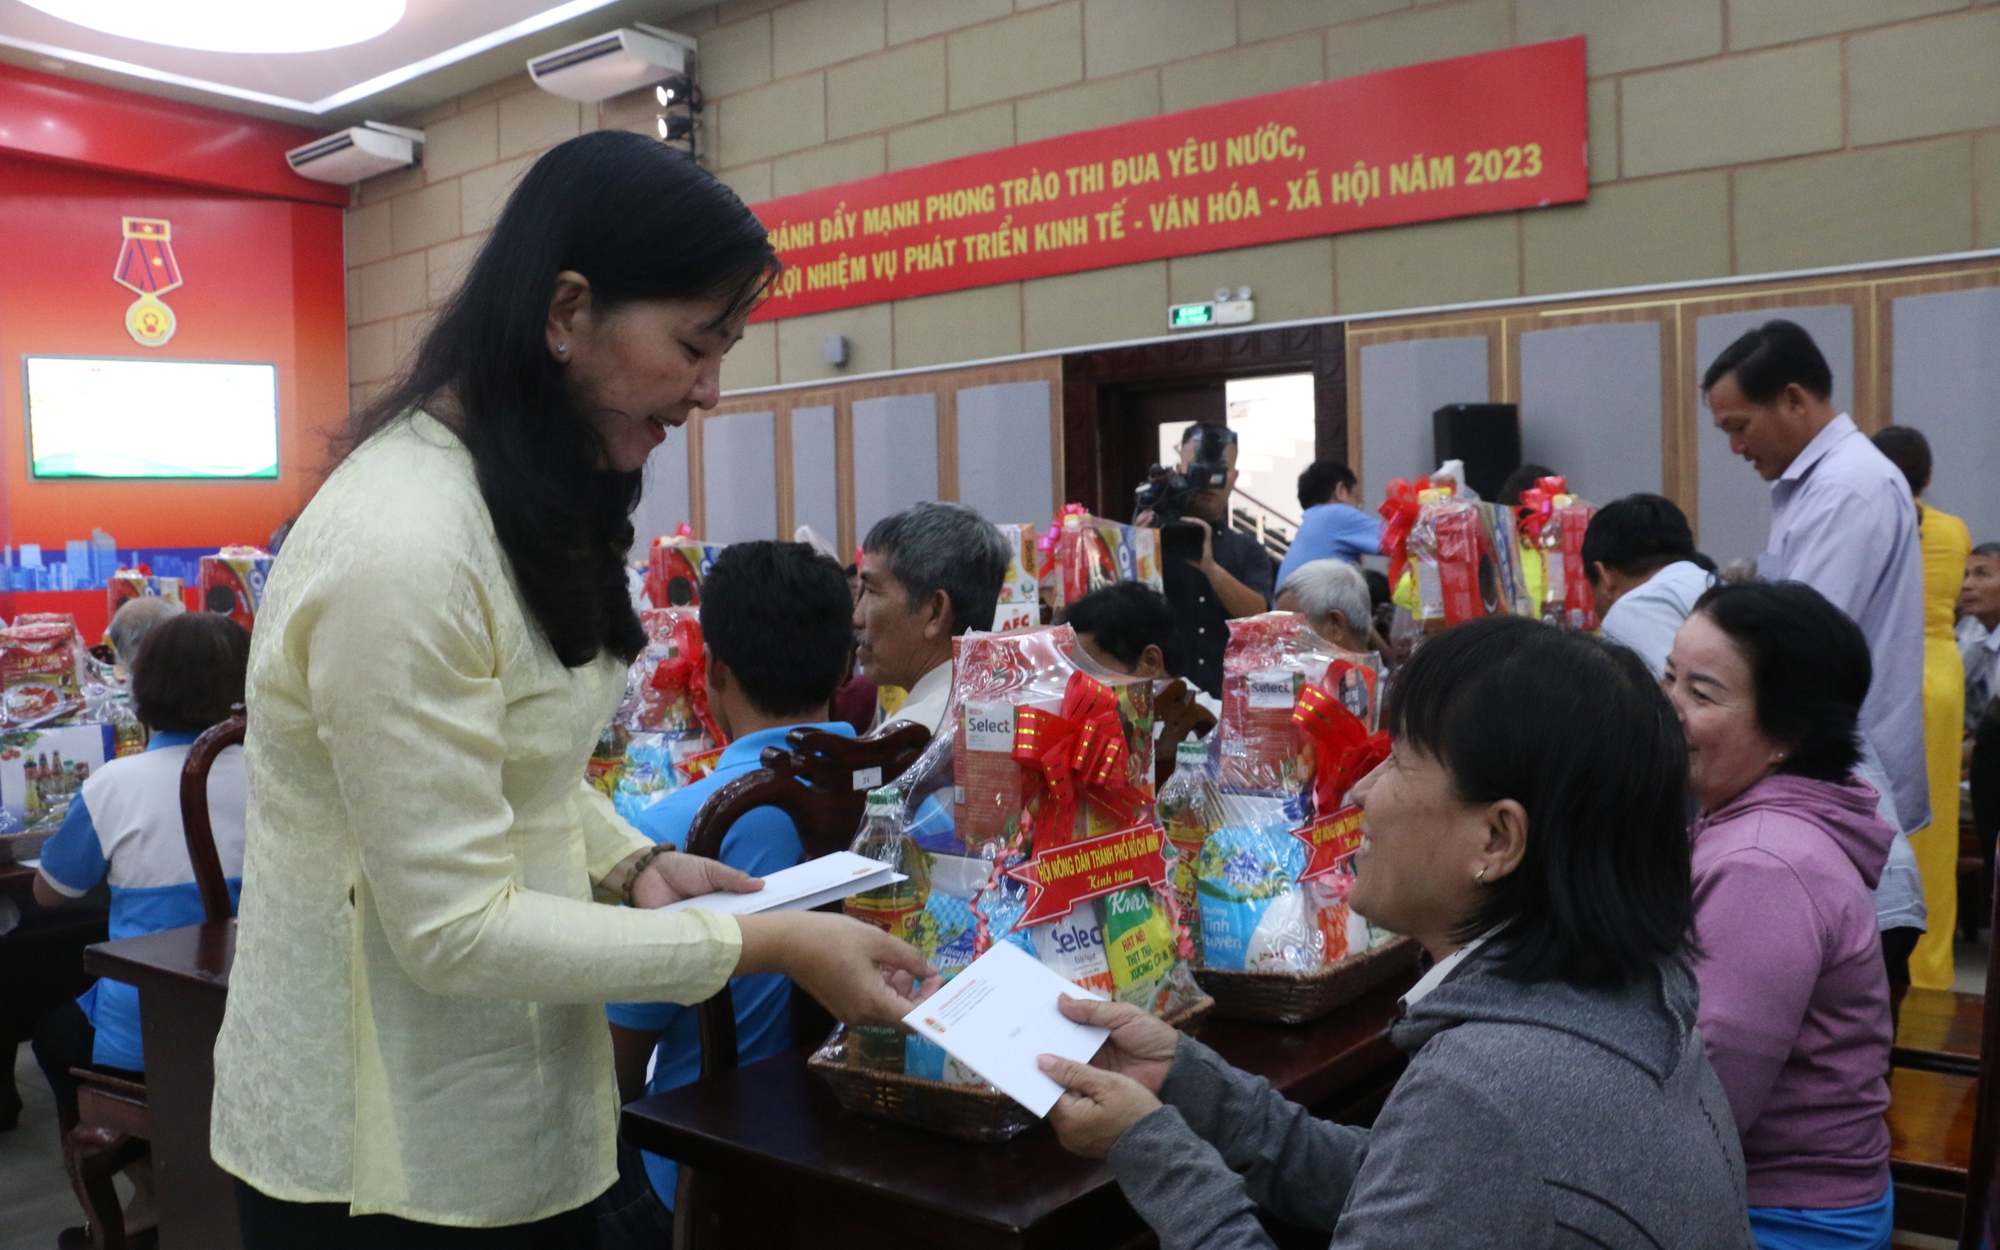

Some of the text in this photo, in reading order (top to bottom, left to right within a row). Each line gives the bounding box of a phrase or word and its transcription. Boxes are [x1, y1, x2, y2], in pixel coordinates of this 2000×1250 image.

[767, 121, 1305, 254] HÁNH ĐẨY MẠNH PHONG TRÀO THI ĐUA YÊU NƯỚC,
[807, 252, 867, 291] NHIỆM
[872, 249, 898, 283] VỤ
[904, 234, 957, 274] PHÁT
[963, 214, 1028, 263] TRIỂN
[1034, 215, 1088, 252] KINH
[1095, 197, 1128, 241] TẾ
[1149, 194, 1200, 233] VĂN
[1207, 181, 1261, 224] HÓA
[1286, 168, 1322, 212] XÃ
[1331, 160, 1380, 208] HỘI
[1390, 152, 1455, 195] NĂM
[1464, 143, 1543, 185] 2023
[1251, 682, 1290, 694] Select
[968, 717, 1011, 734] Select
[1037, 862, 1052, 886] HỘI
[1051, 855, 1075, 882] NÔNG
[1074, 848, 1091, 873] DÂN
[1091, 844, 1114, 869] THÀNH
[1114, 835, 1129, 863] PHỐ
[1051, 925, 1104, 954] Selec
